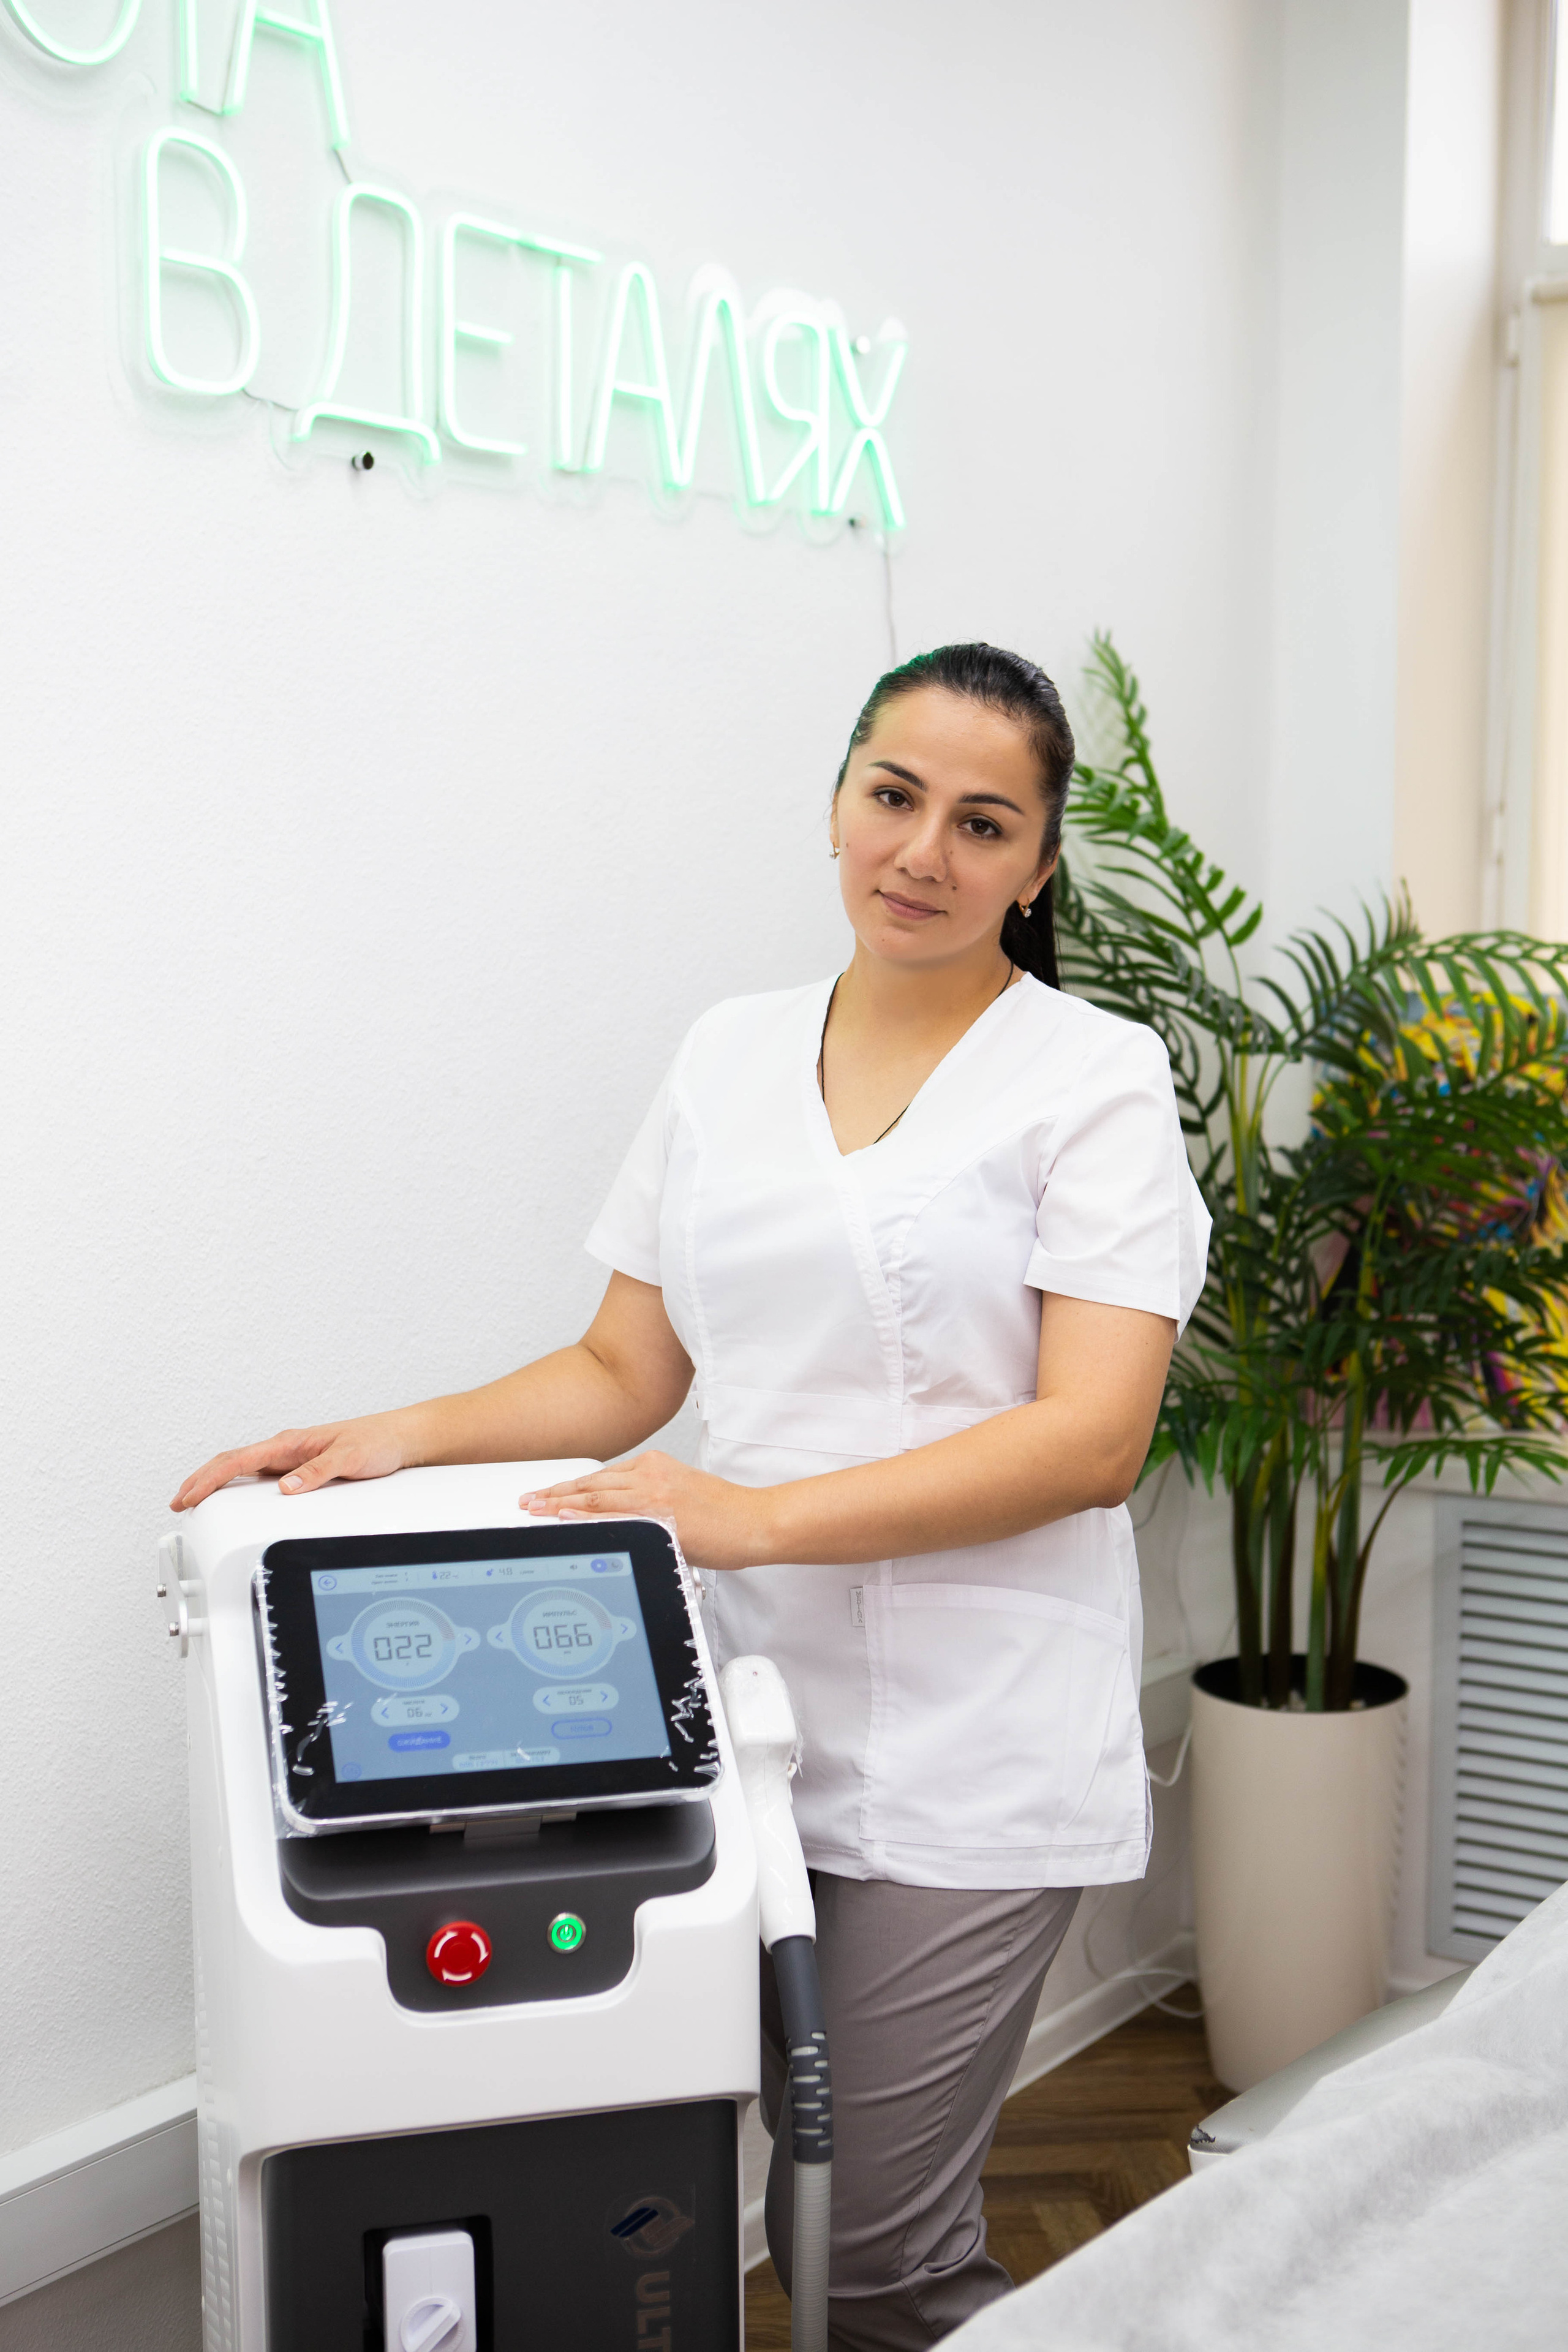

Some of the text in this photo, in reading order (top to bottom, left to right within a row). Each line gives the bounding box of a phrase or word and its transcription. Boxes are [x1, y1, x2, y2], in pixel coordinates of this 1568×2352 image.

[143, 127, 908, 530] В ДЕТАЛЯХ
[374, 1635, 431, 1660] 022
[533, 1624, 592, 1649] 066
